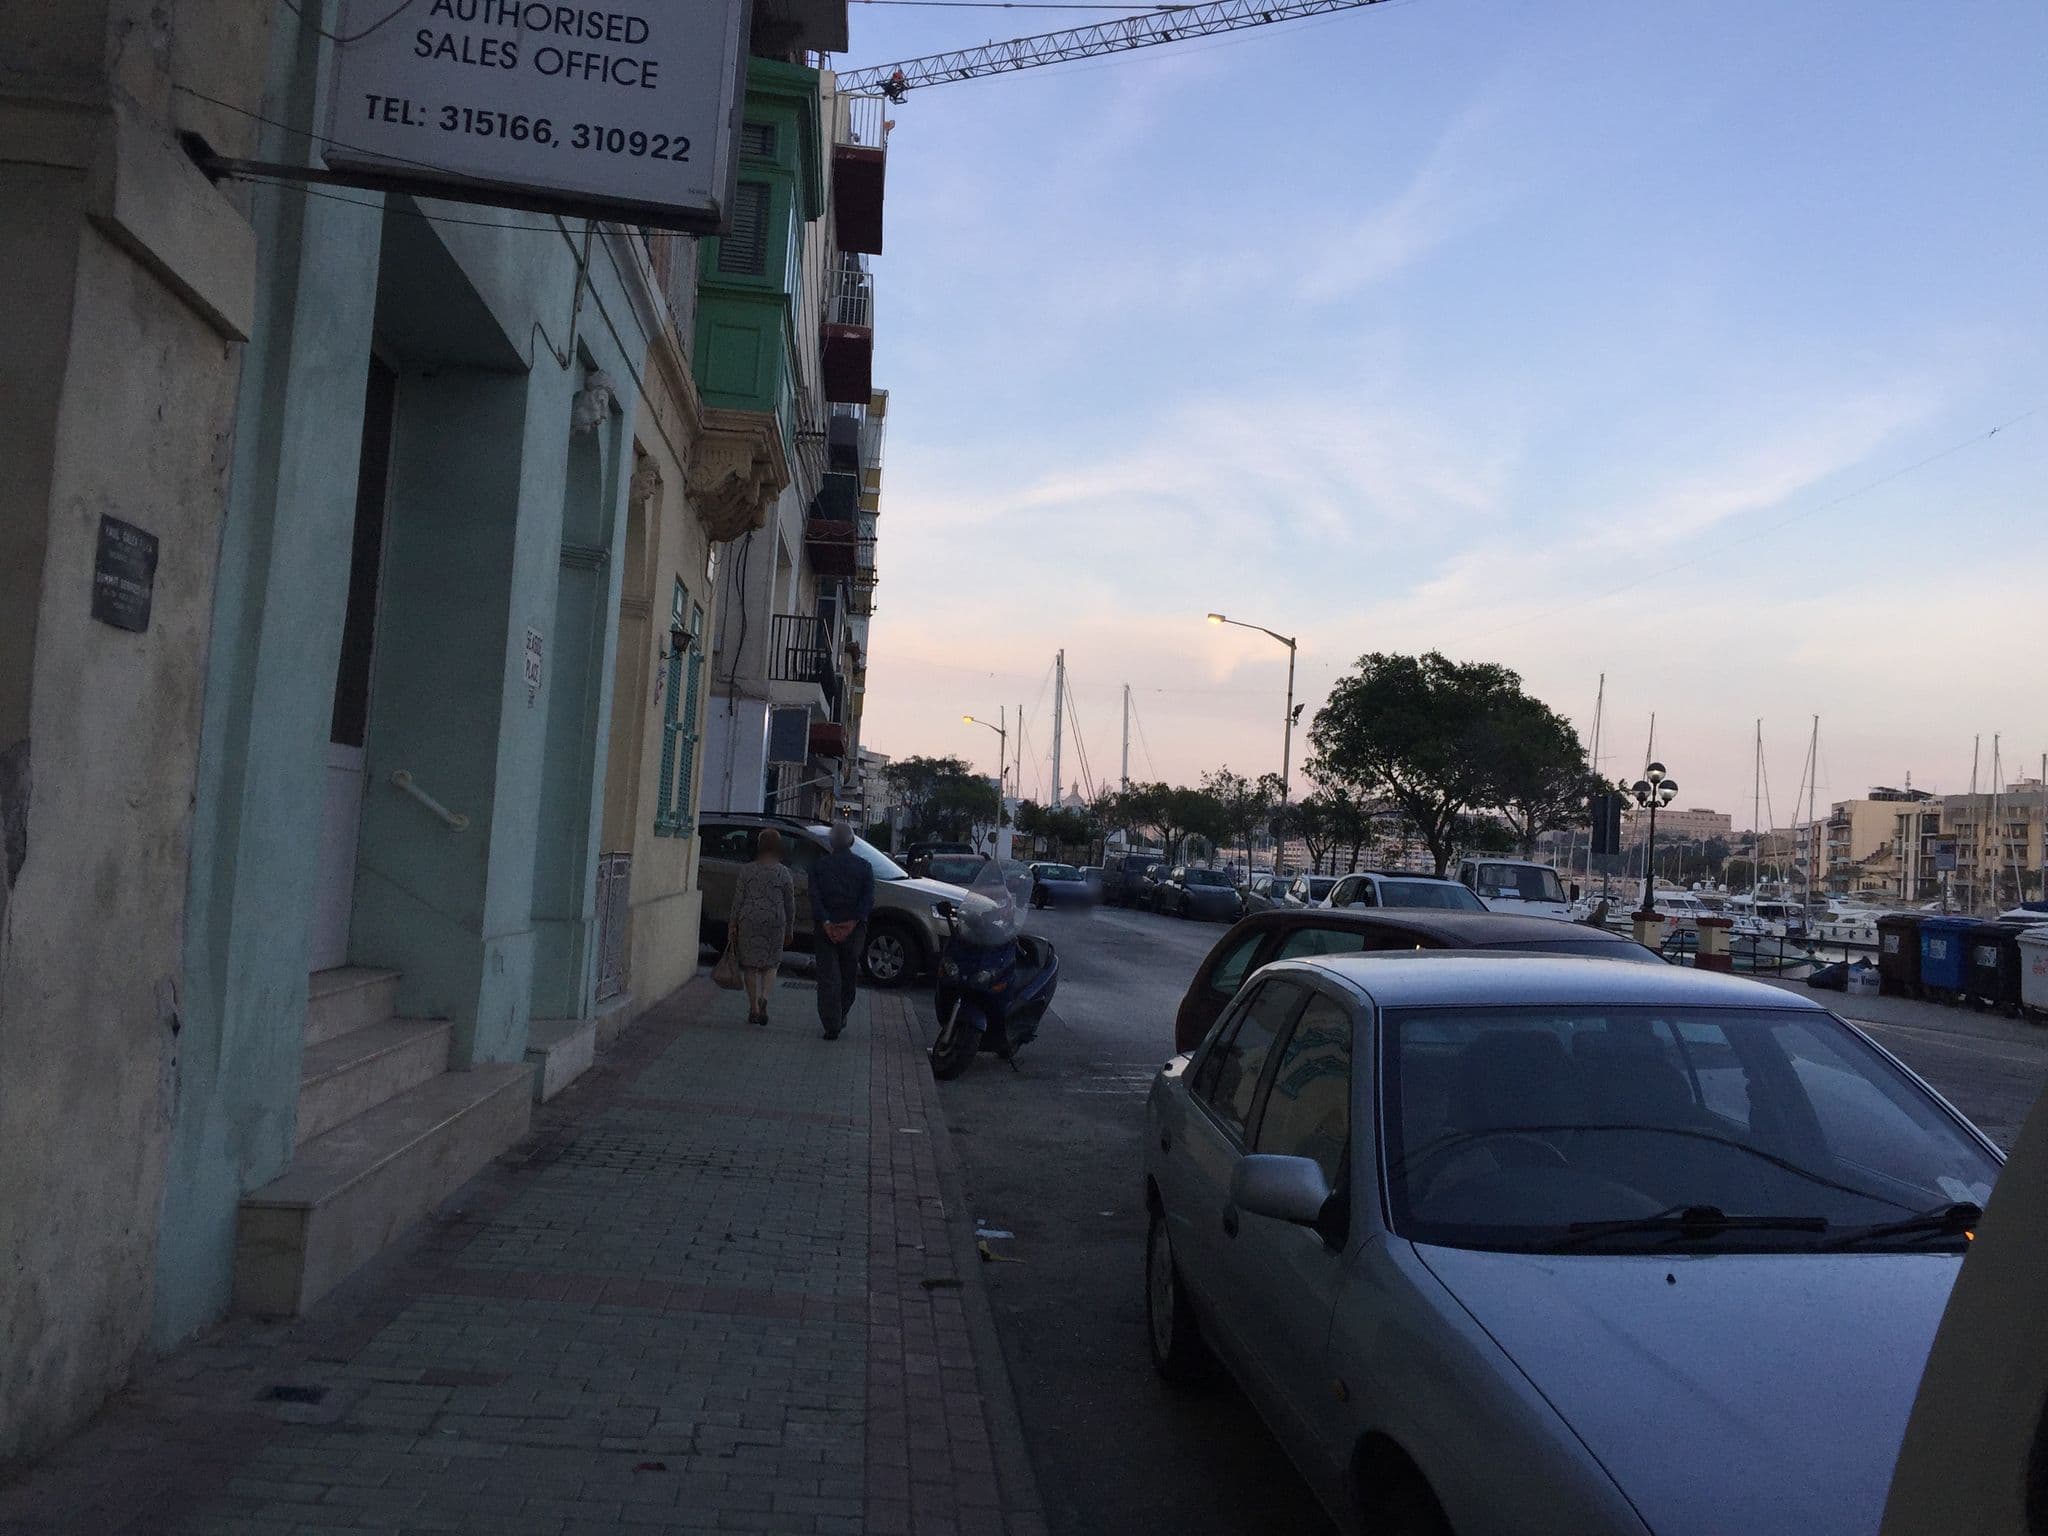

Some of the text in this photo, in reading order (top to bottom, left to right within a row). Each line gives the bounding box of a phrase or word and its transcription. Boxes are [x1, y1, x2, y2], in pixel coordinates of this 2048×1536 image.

[430, 0, 649, 44] AUTHORISED
[414, 30, 658, 89] SALES OFFICE
[365, 95, 691, 162] TEL: 315166, 310922
